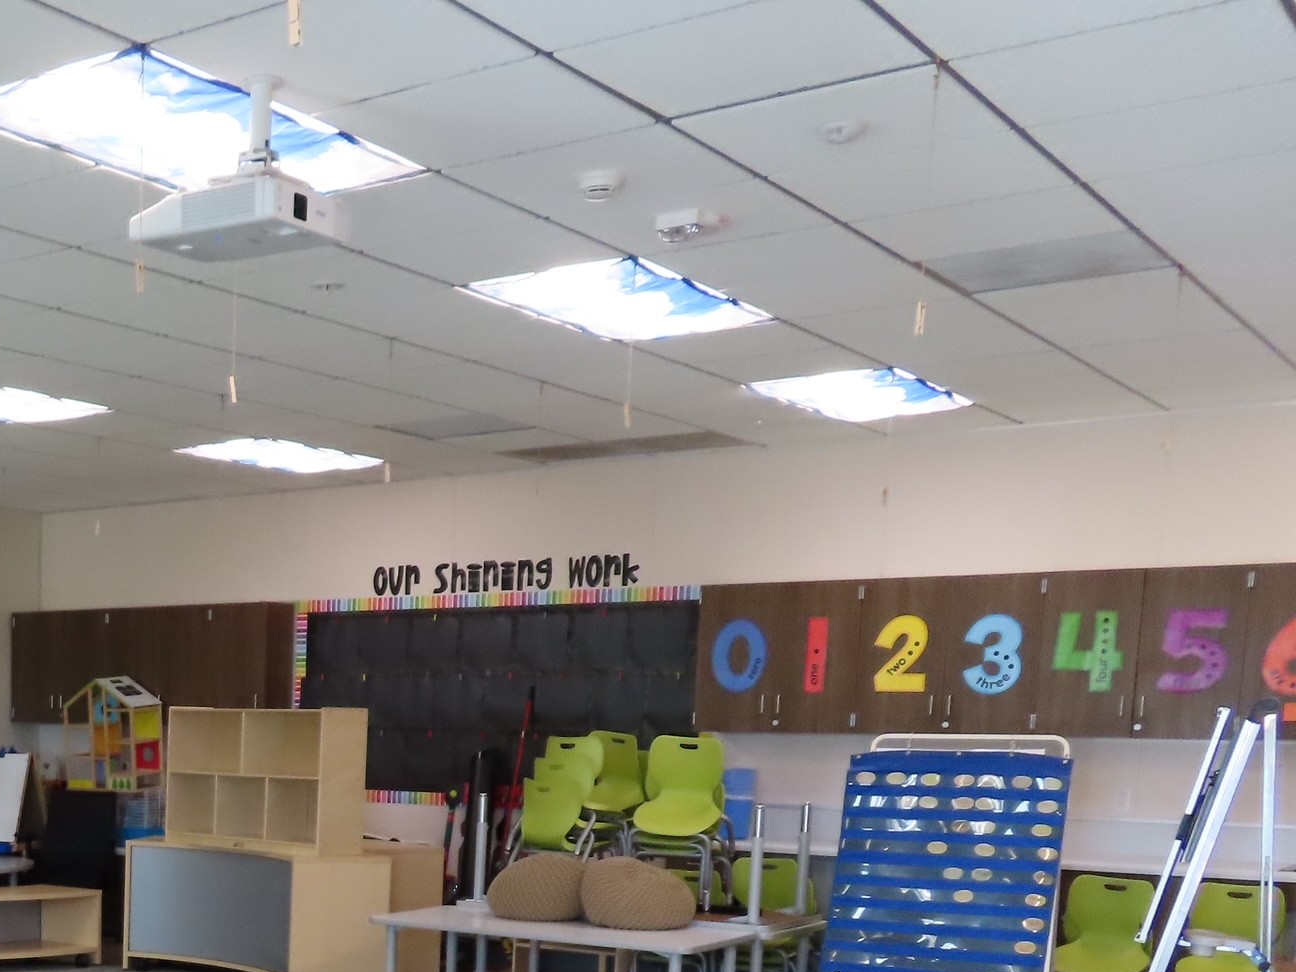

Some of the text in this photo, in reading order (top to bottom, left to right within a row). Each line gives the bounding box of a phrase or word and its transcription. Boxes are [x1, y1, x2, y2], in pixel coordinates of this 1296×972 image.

[712, 618, 768, 693] 0
[804, 617, 829, 693] 1
[874, 614, 929, 693] 2
[964, 613, 1022, 694] 3
[1054, 610, 1123, 692] 4
[1157, 608, 1228, 691] 5
[810, 663, 819, 685] one
[886, 657, 907, 676] two
[1095, 658, 1108, 683] four
[975, 673, 1011, 690] three
